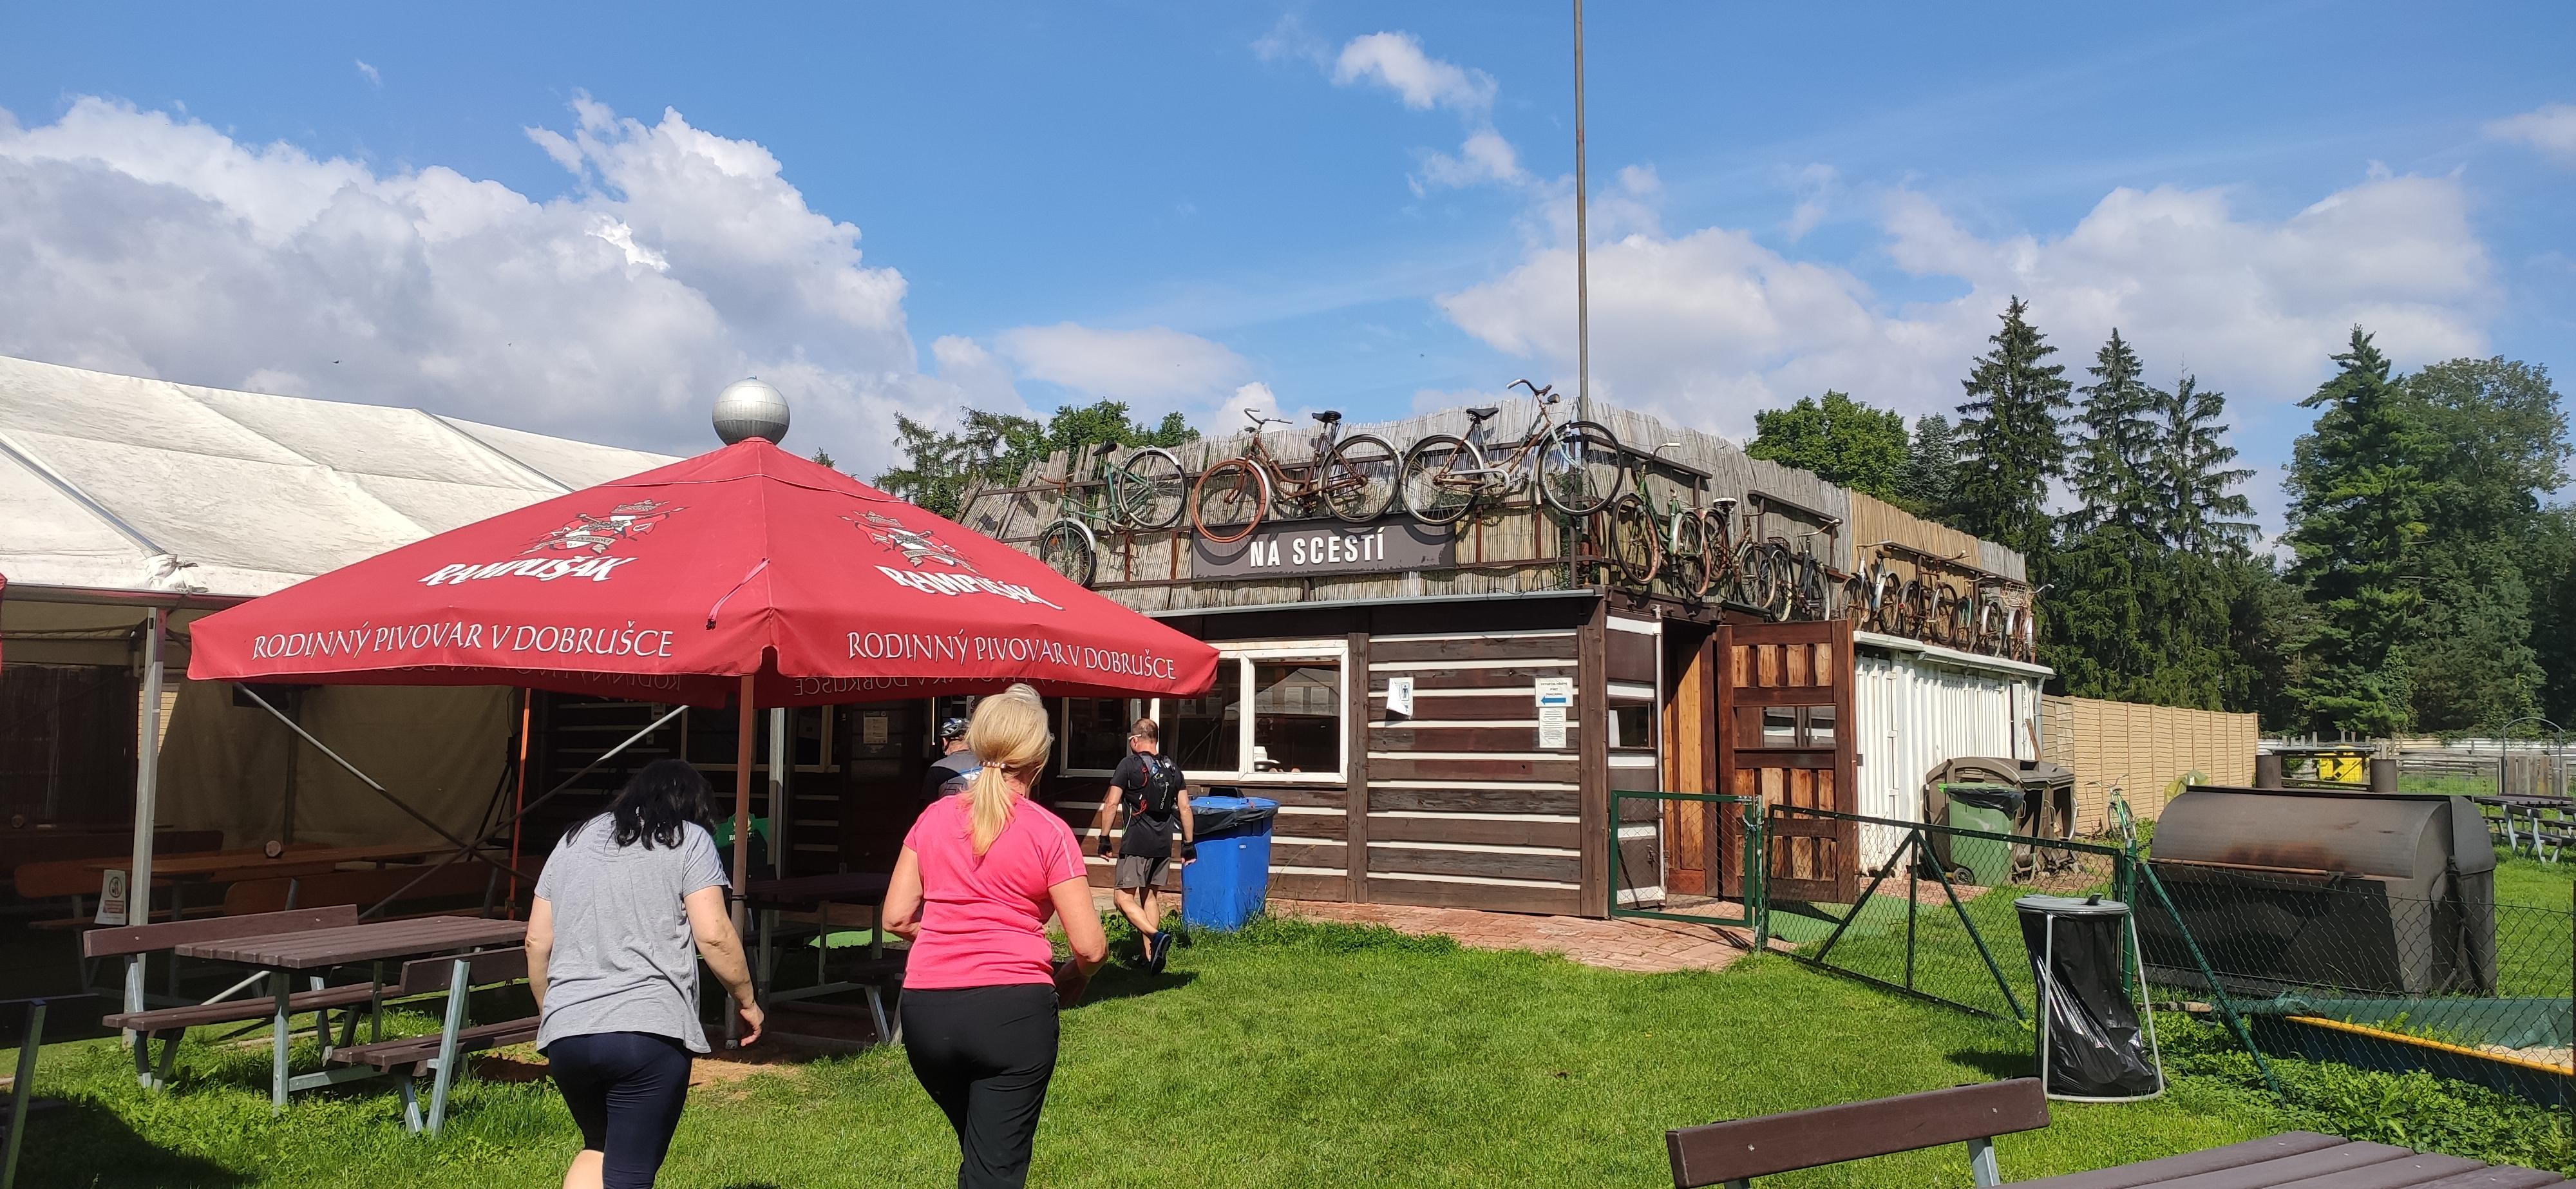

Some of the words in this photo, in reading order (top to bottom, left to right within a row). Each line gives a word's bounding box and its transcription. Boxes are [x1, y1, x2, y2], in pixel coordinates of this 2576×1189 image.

[1249, 540, 1282, 567] NA
[1292, 526, 1386, 566] SCESTÍ
[417, 555, 639, 585] RAMPUŠÁK
[873, 564, 1066, 611] RAMPUŠÁK
[252, 622, 370, 660] RODINNÝ
[373, 621, 482, 652] PIVOVAR
[491, 624, 513, 651] V
[511, 620, 674, 657] DOBRUŠCE
[846, 628, 968, 665] RODINNÝ
[973, 636, 1069, 667] PIVOVAR
[1066, 644, 1081, 667] V
[1083, 648, 1177, 680] DOBRUŠCE
